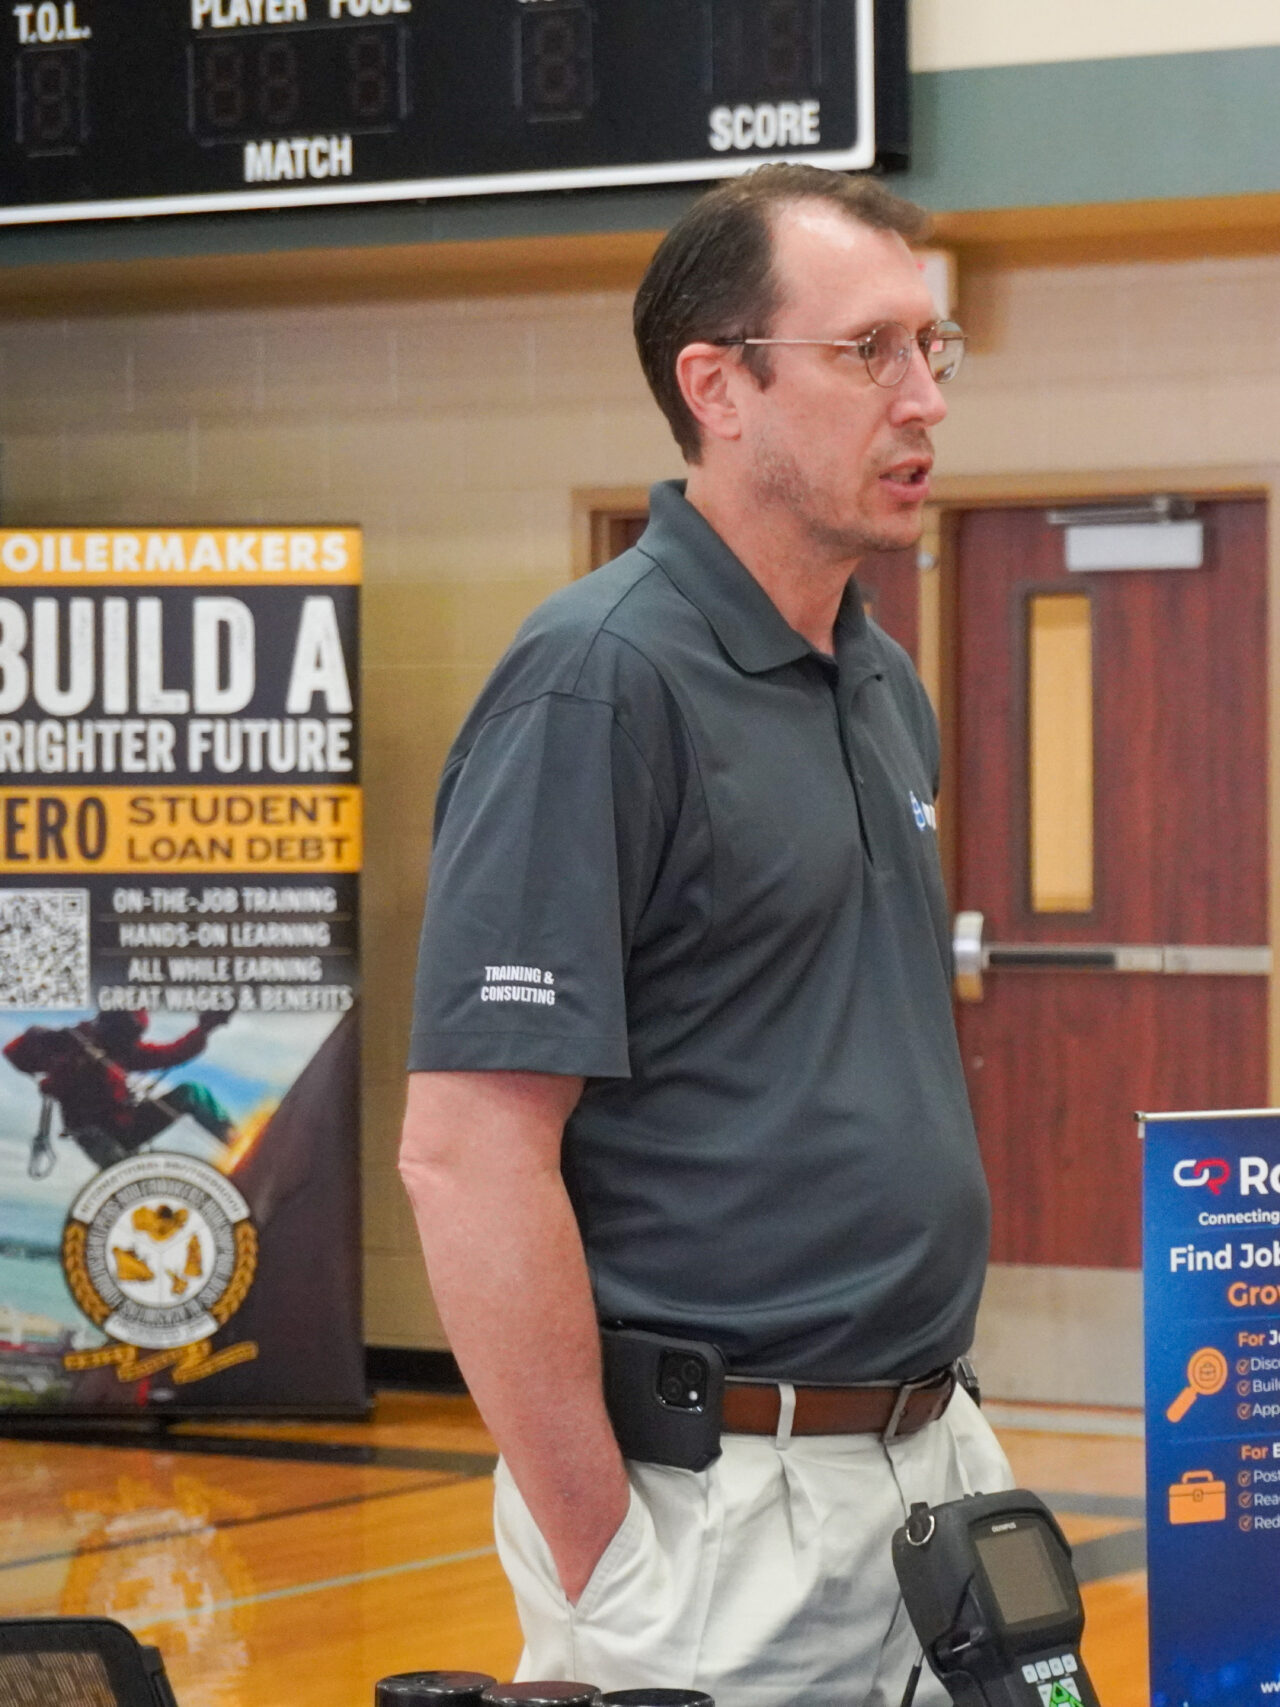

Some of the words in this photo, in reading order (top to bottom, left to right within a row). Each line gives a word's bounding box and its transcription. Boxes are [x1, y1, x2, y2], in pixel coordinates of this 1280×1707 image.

[13, 3, 92, 44] T.O.L.
[709, 99, 821, 152] SCORE
[243, 136, 353, 183] MATCH
[2, 533, 348, 572] OILERMAKERS
[285, 594, 353, 714] A
[188, 718, 353, 773] FUTURE
[128, 795, 349, 826] STUDENT
[128, 836, 234, 863] LOAN
[245, 835, 350, 862] DEBT
[112, 886, 240, 914] ON-THE-JOB
[241, 886, 338, 913] TRAINING
[119, 922, 228, 948] HANDS-ON
[231, 921, 331, 948] LEARNING
[128, 956, 165, 982] ALL
[167, 956, 231, 982] WHILE
[232, 956, 322, 982] EARNING
[484, 965, 542, 983] TRAINING
[543, 971, 555, 985] &
[98, 985, 163, 1012] GREAT
[164, 985, 235, 1012] WAGES
[259, 984, 354, 1011] BENEFITS
[481, 985, 556, 1006] CONSULTING
[1198, 1208, 1280, 1227] Connecting
[1170, 1243, 1233, 1273] Find
[1238, 1331, 1266, 1348] For
[1240, 1444, 1268, 1461] For
